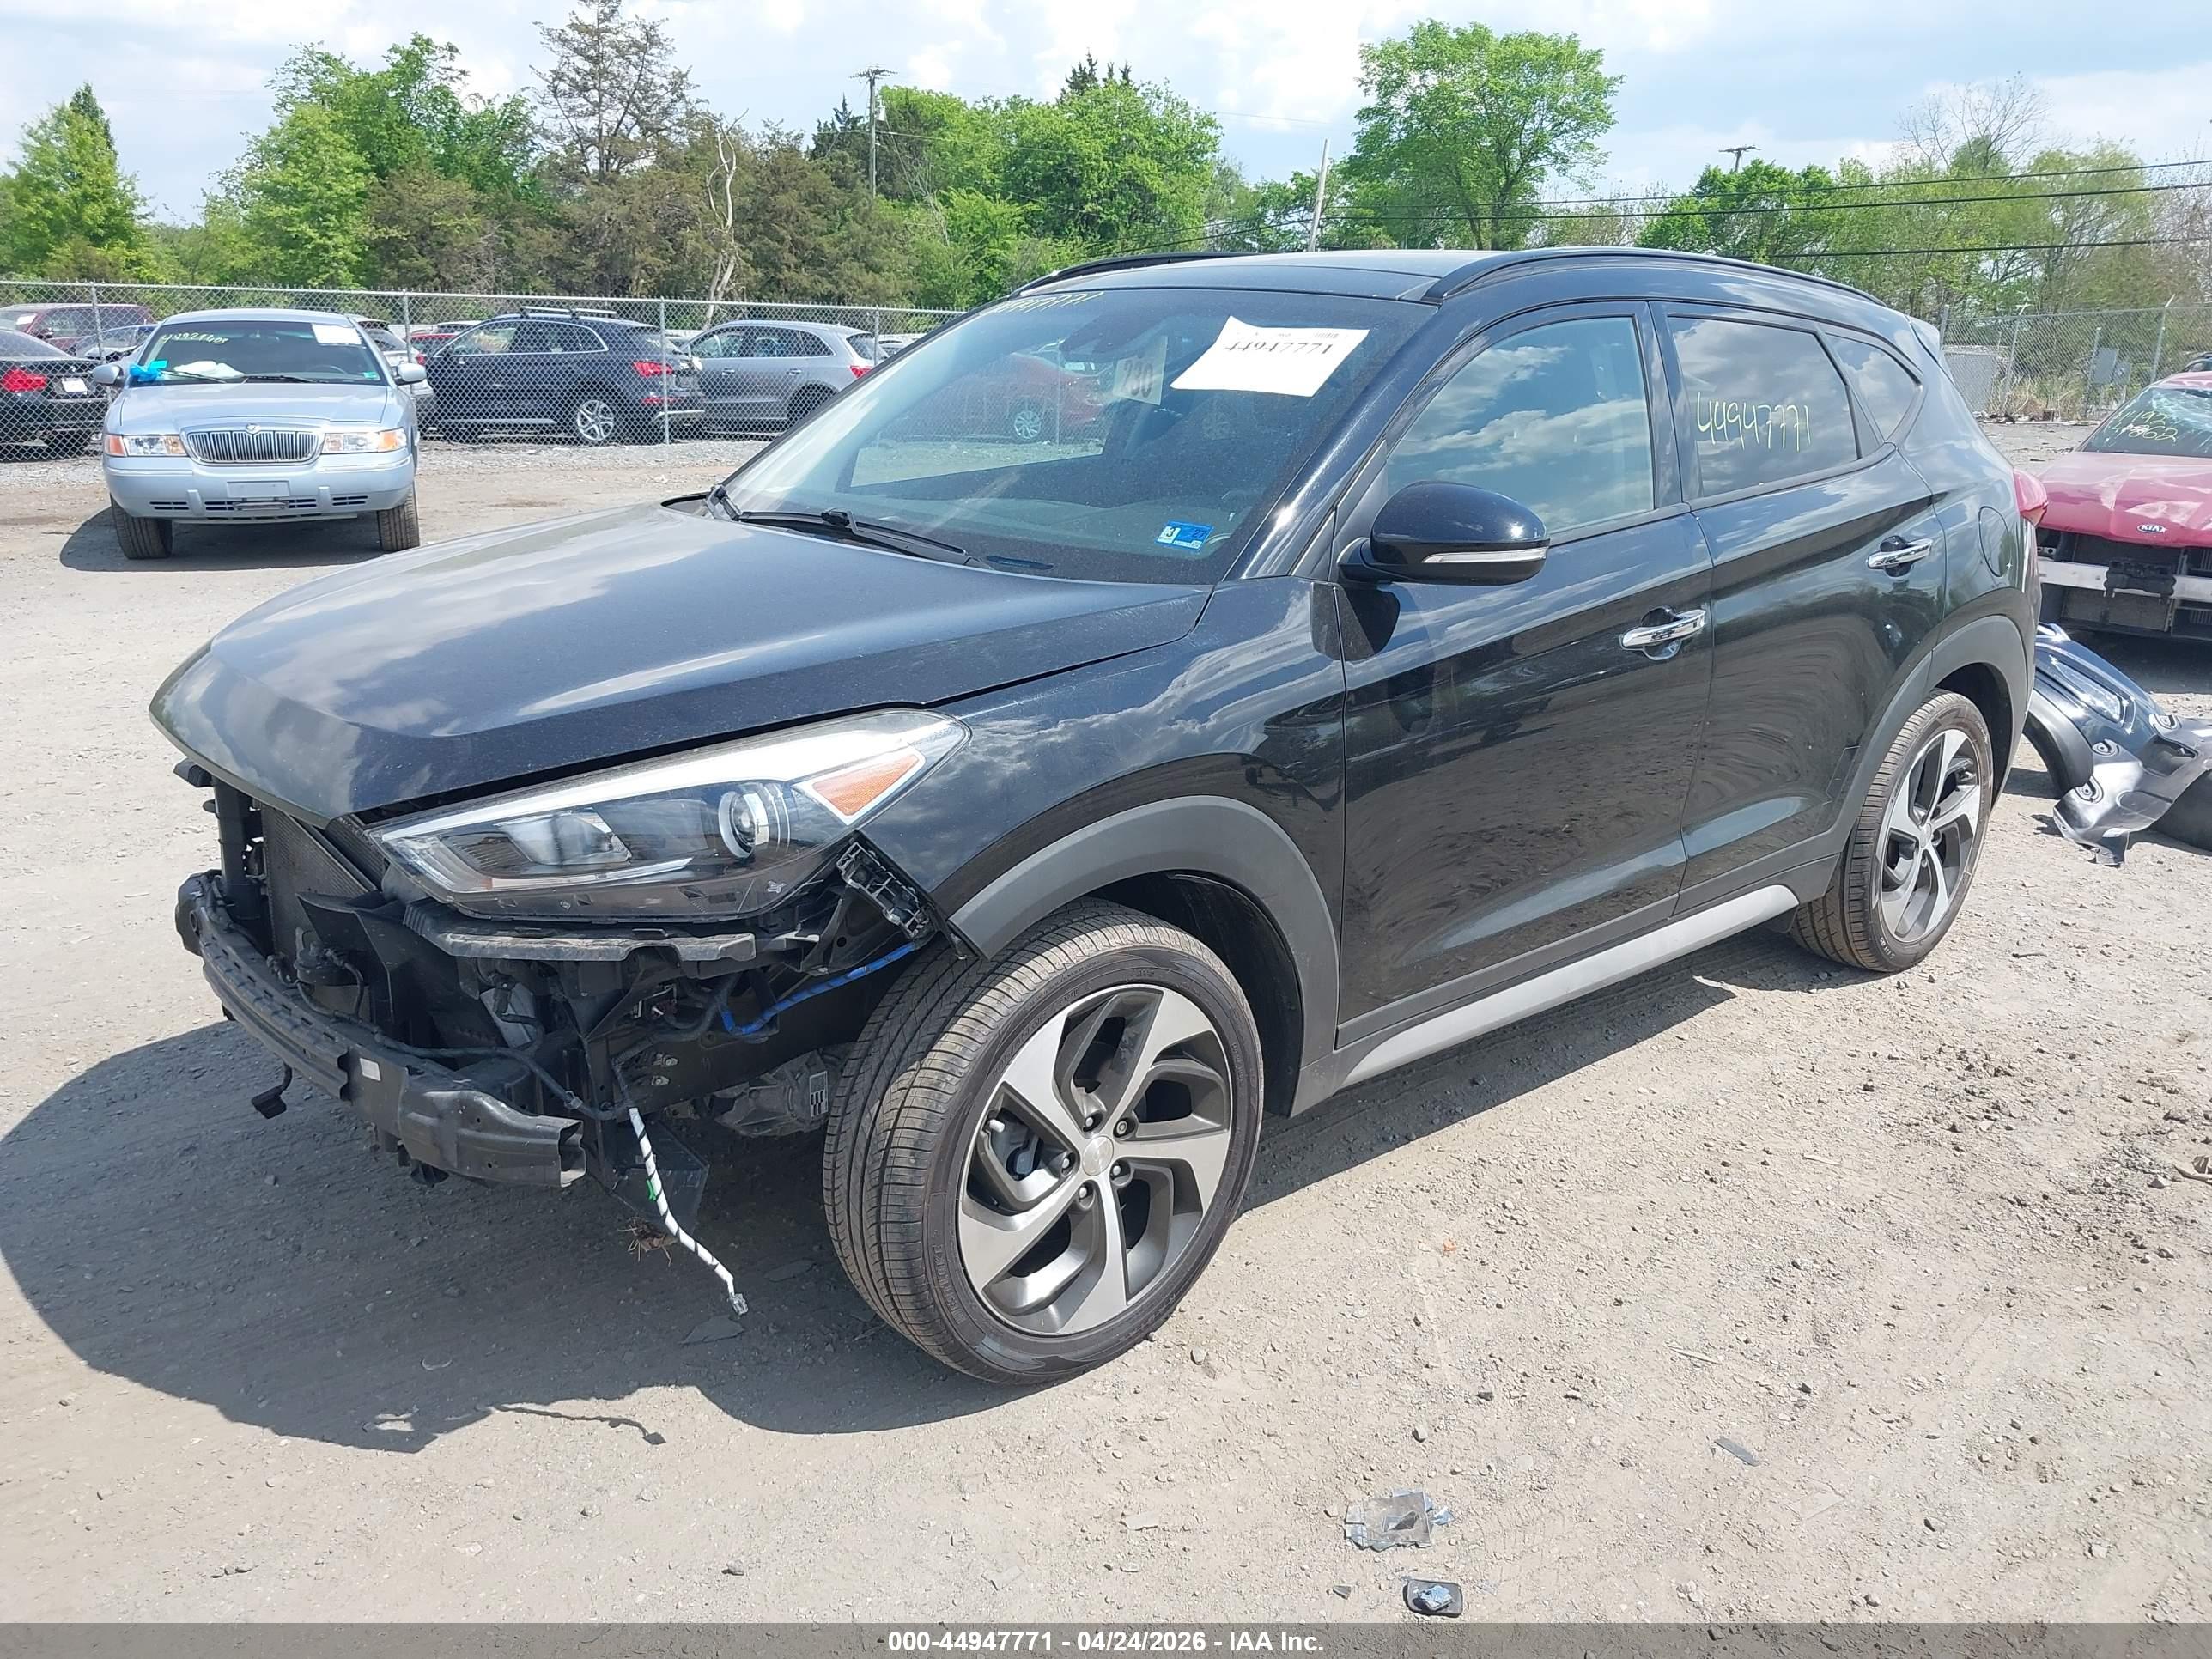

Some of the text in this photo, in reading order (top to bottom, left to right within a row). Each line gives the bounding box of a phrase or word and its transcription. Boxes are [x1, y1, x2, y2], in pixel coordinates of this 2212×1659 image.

[1224, 341, 1334, 355] 44947771
[1697, 391, 1812, 453] 44947771
[2140, 524, 2160, 532] KIA
